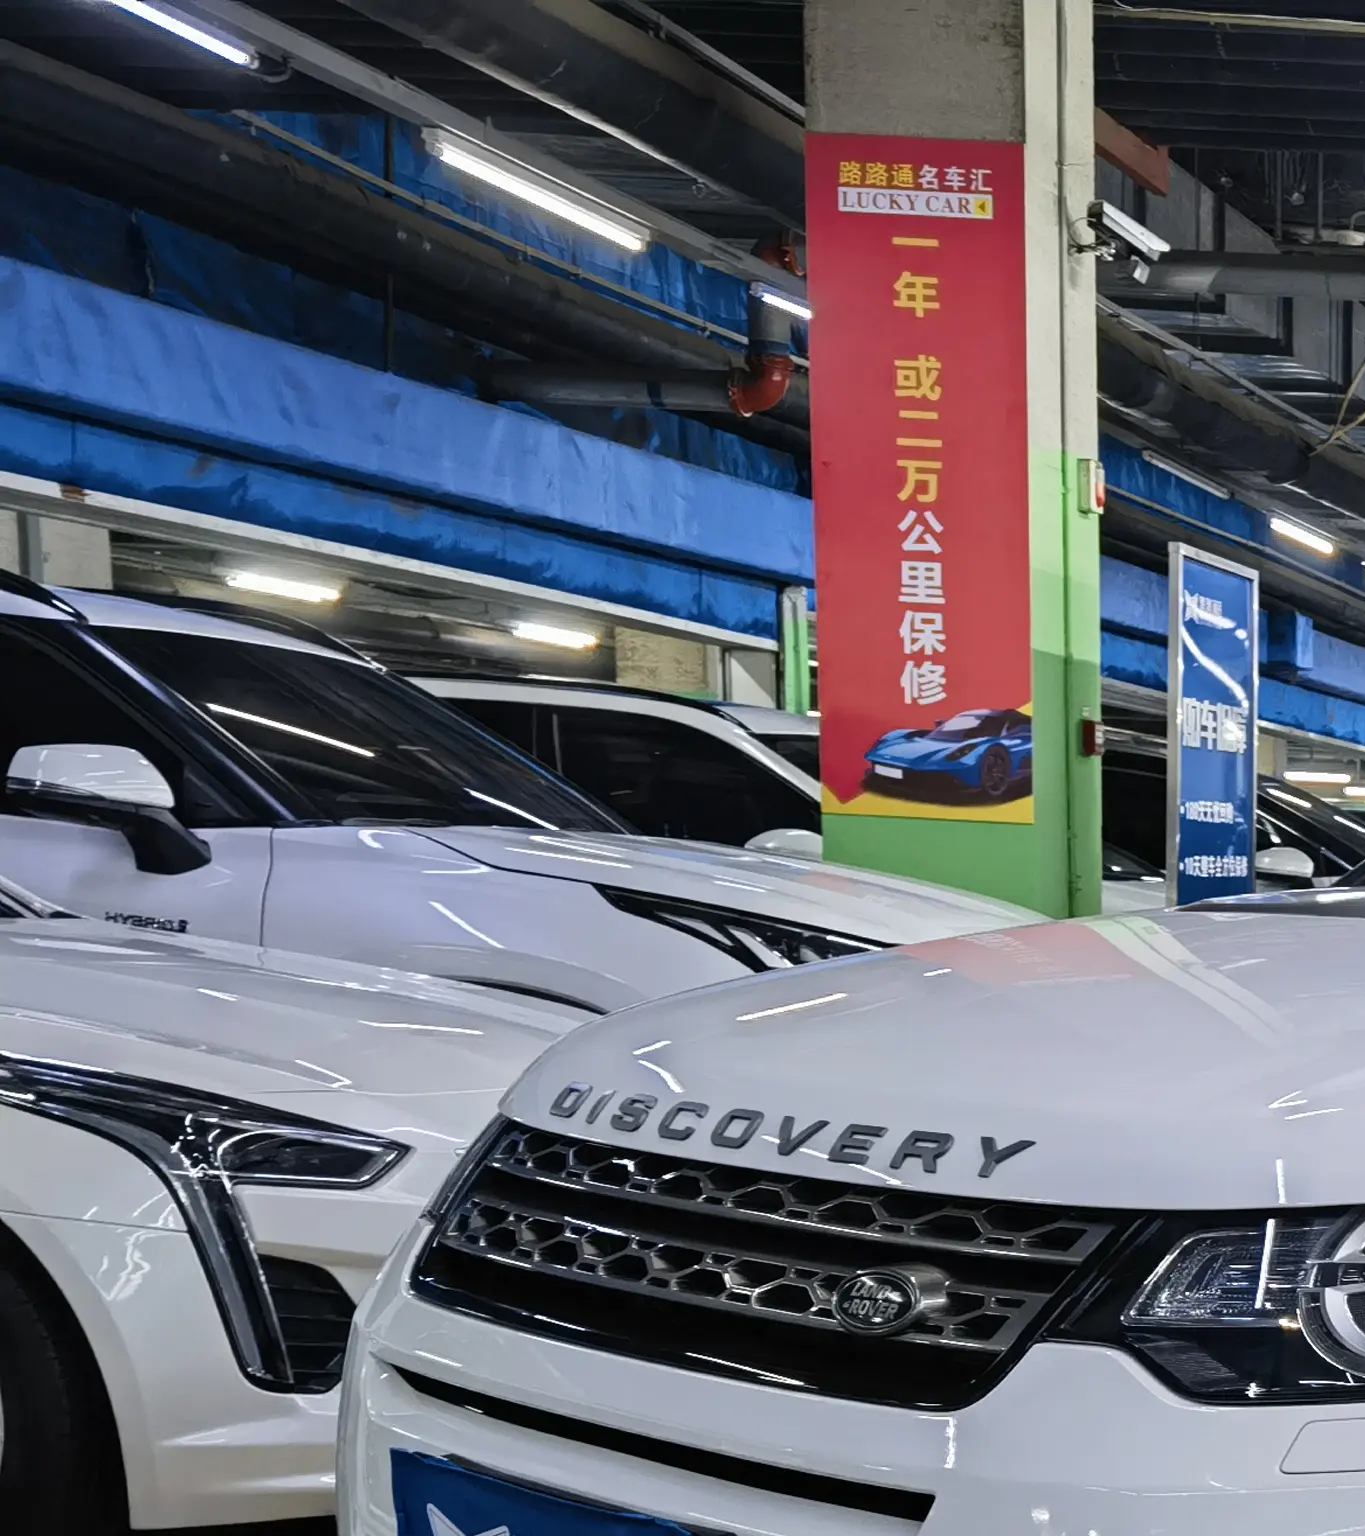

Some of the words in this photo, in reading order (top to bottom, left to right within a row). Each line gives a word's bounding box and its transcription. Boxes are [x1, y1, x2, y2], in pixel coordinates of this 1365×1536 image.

[838, 160, 993, 192] 路路通名车汇
[841, 191, 919, 212] LUCKY
[925, 195, 972, 214] CAR
[892, 236, 940, 318] 一年
[893, 354, 947, 706] 或二万公里保修
[549, 1081, 1037, 1179] DISCOVERY
[850, 1282, 893, 1299] LAND
[848, 1299, 899, 1320] ROVER
